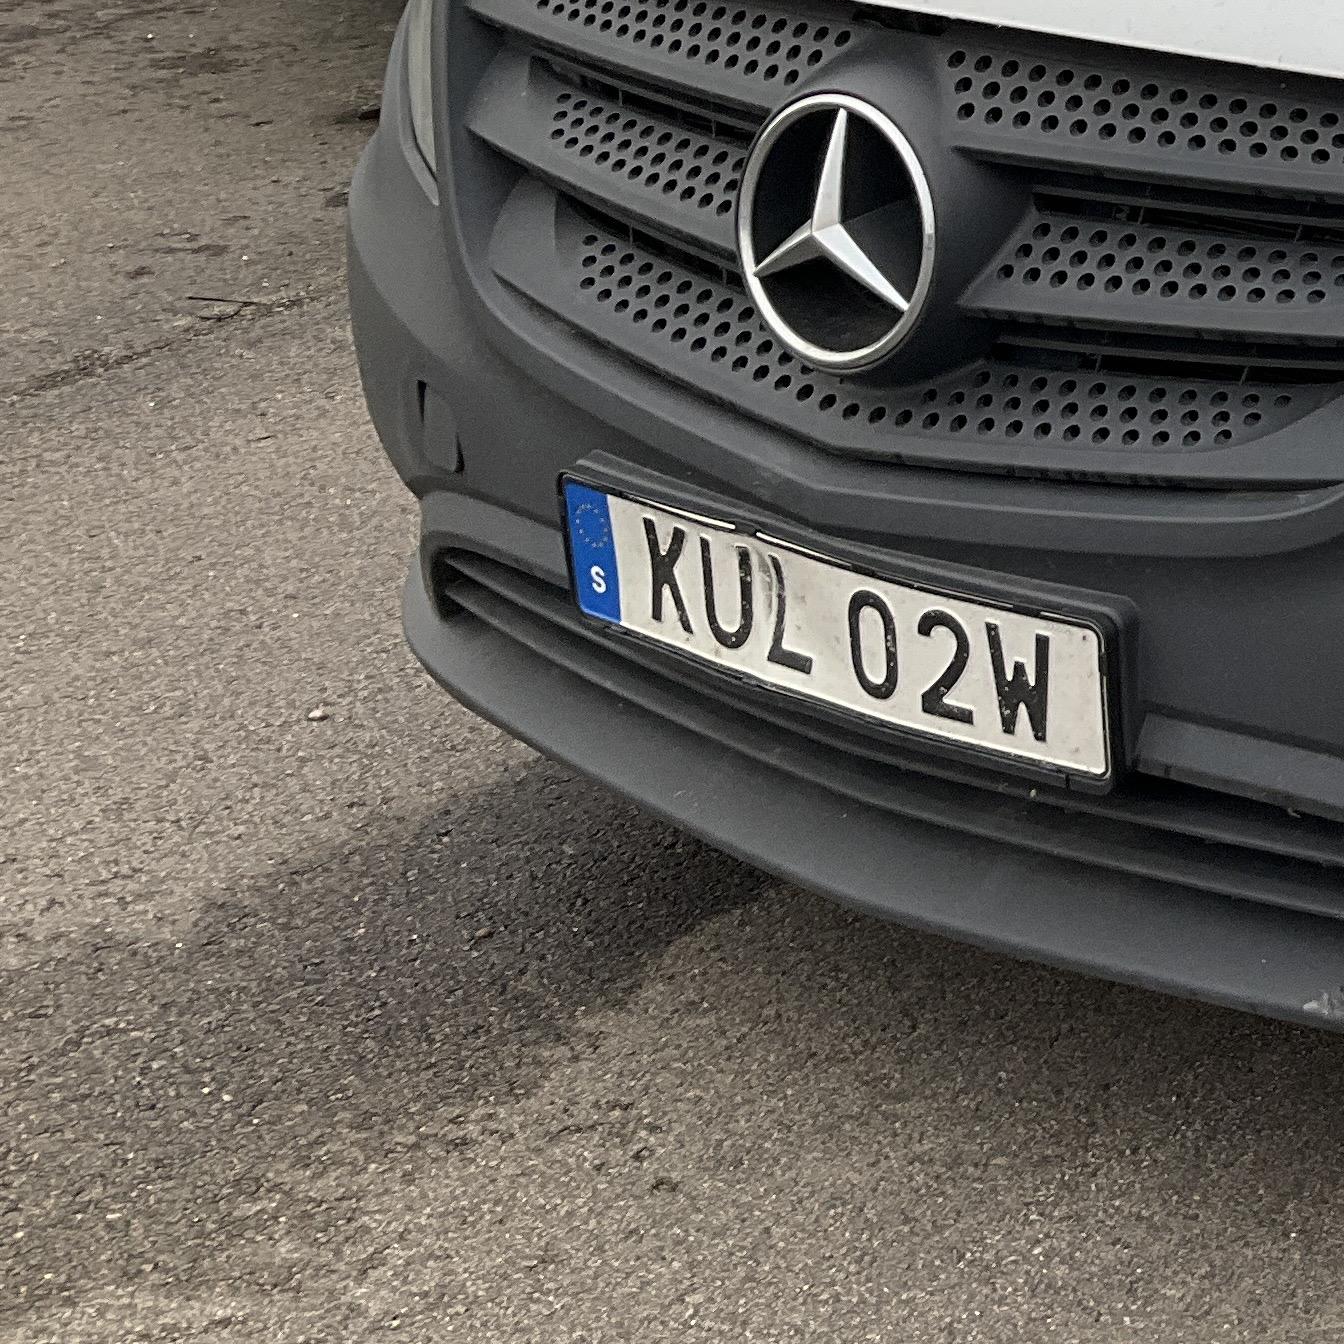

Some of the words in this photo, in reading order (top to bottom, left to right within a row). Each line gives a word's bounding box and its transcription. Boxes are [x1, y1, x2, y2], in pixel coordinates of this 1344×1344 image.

[590, 565, 607, 594] S
[641, 516, 813, 675] KUL
[847, 588, 1051, 743] 02W
